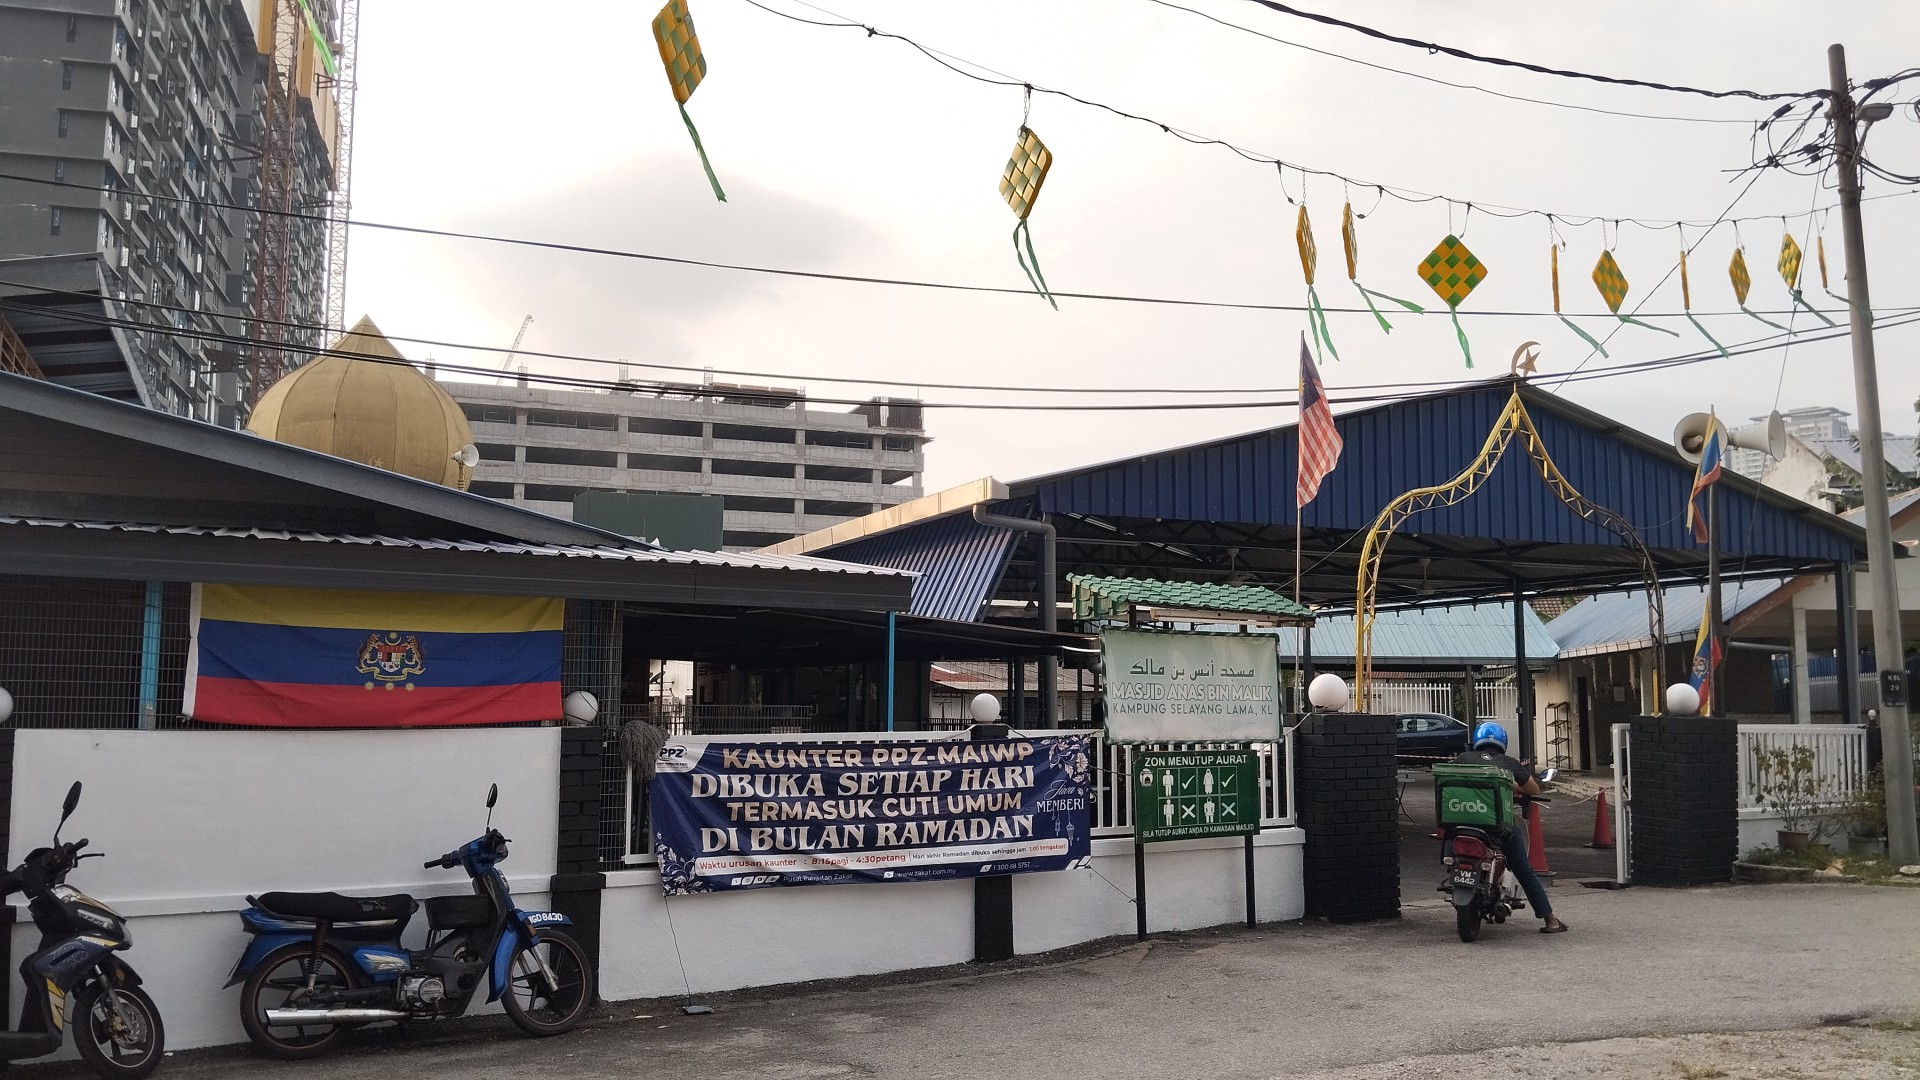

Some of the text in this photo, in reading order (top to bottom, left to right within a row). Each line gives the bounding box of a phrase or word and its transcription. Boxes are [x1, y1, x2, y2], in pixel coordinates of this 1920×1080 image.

[1129, 658, 1255, 683] مسجد أنس بن مالك
[1111, 682, 1273, 703] MASJID ANAS BIN MALIK
[1113, 703, 1273, 716] KAMPUNG SELAYANG LAMA, KL
[659, 748, 685, 758] PPZ
[723, 742, 1034, 769] KAUNTER PPZ-MAIWP
[1144, 755, 1248, 767] ZON MENUTUP AURAT
[691, 765, 1035, 798] DIBUKA SETIAP HARI
[726, 792, 1022, 822] TERMASUK CUTI UMUM
[1036, 798, 1084, 813] MEMBERI
[1448, 798, 1488, 813] Grab
[700, 814, 1035, 853] DI BULAN RAMADAN
[1142, 830, 1155, 838] SILA
[1155, 829, 1172, 837] TUTUP
[1171, 828, 1189, 836] AURAT
[1236, 823, 1255, 831] MASJID
[700, 861, 726, 870] Waktu
[728, 860, 762, 868] urusan
[764, 858, 797, 867] kaunter
[856, 853, 906, 865] 4:30petang
[912, 852, 925, 860] Hari
[926, 851, 941, 859] akhir
[942, 850, 970, 858] Ramadan
[971, 849, 991, 857] dibuka
[991, 848, 1016, 856] sehingga
[1454, 876, 1475, 885] 6442
[1460, 870, 1472, 878] VM
[541, 912, 563, 921] 8430
